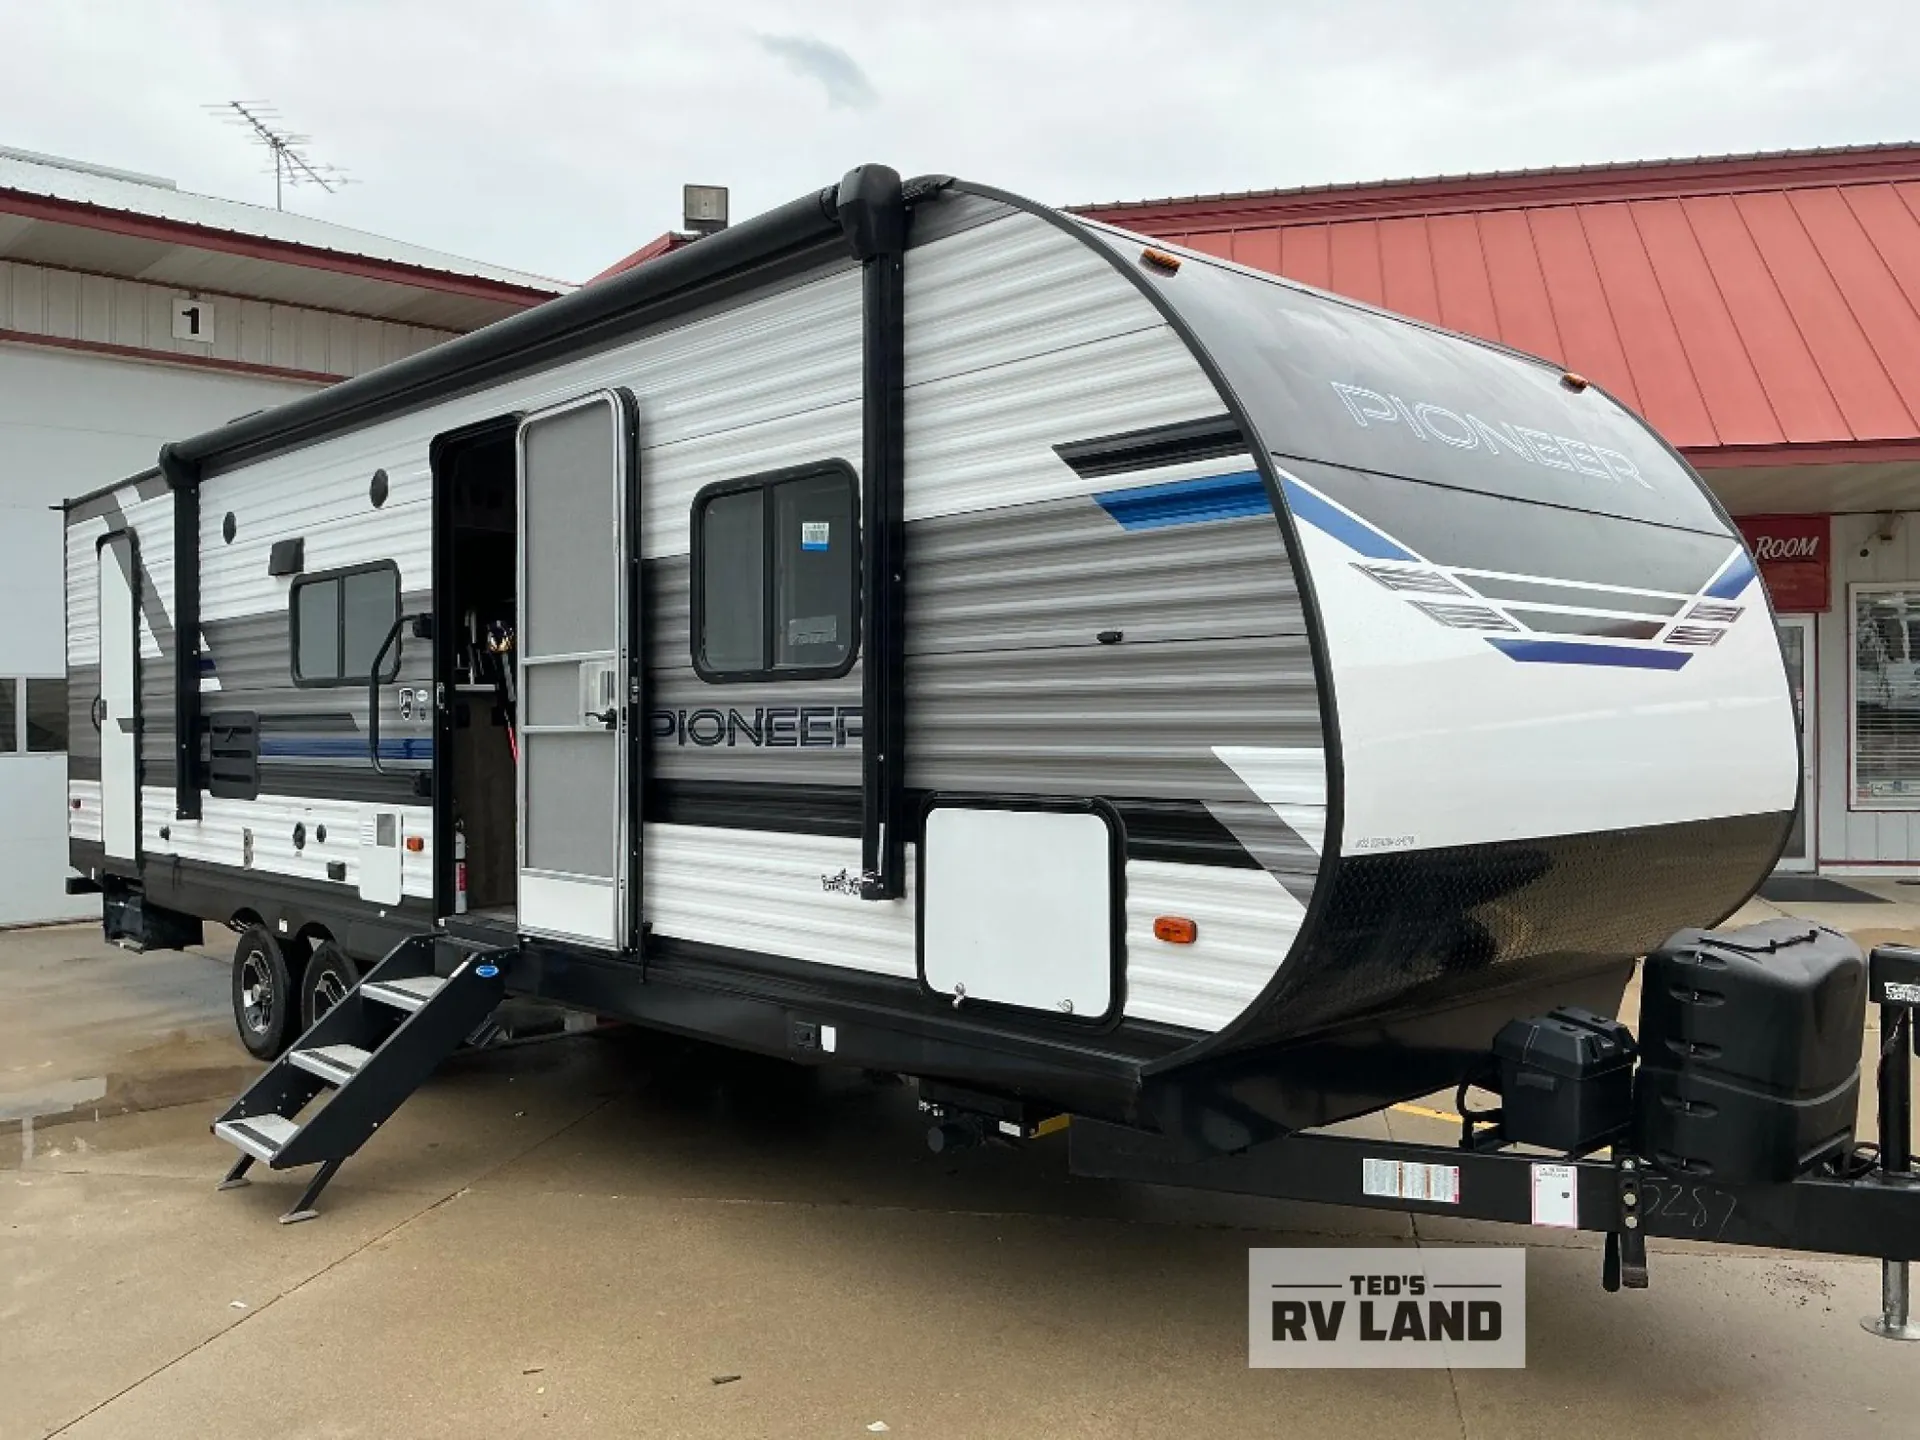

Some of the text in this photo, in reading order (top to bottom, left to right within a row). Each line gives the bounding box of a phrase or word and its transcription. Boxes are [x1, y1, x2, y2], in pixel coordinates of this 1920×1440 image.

[181, 306, 200, 335] 1
[1330, 381, 1656, 491] PIONEER
[1755, 535, 1820, 560] ROOM
